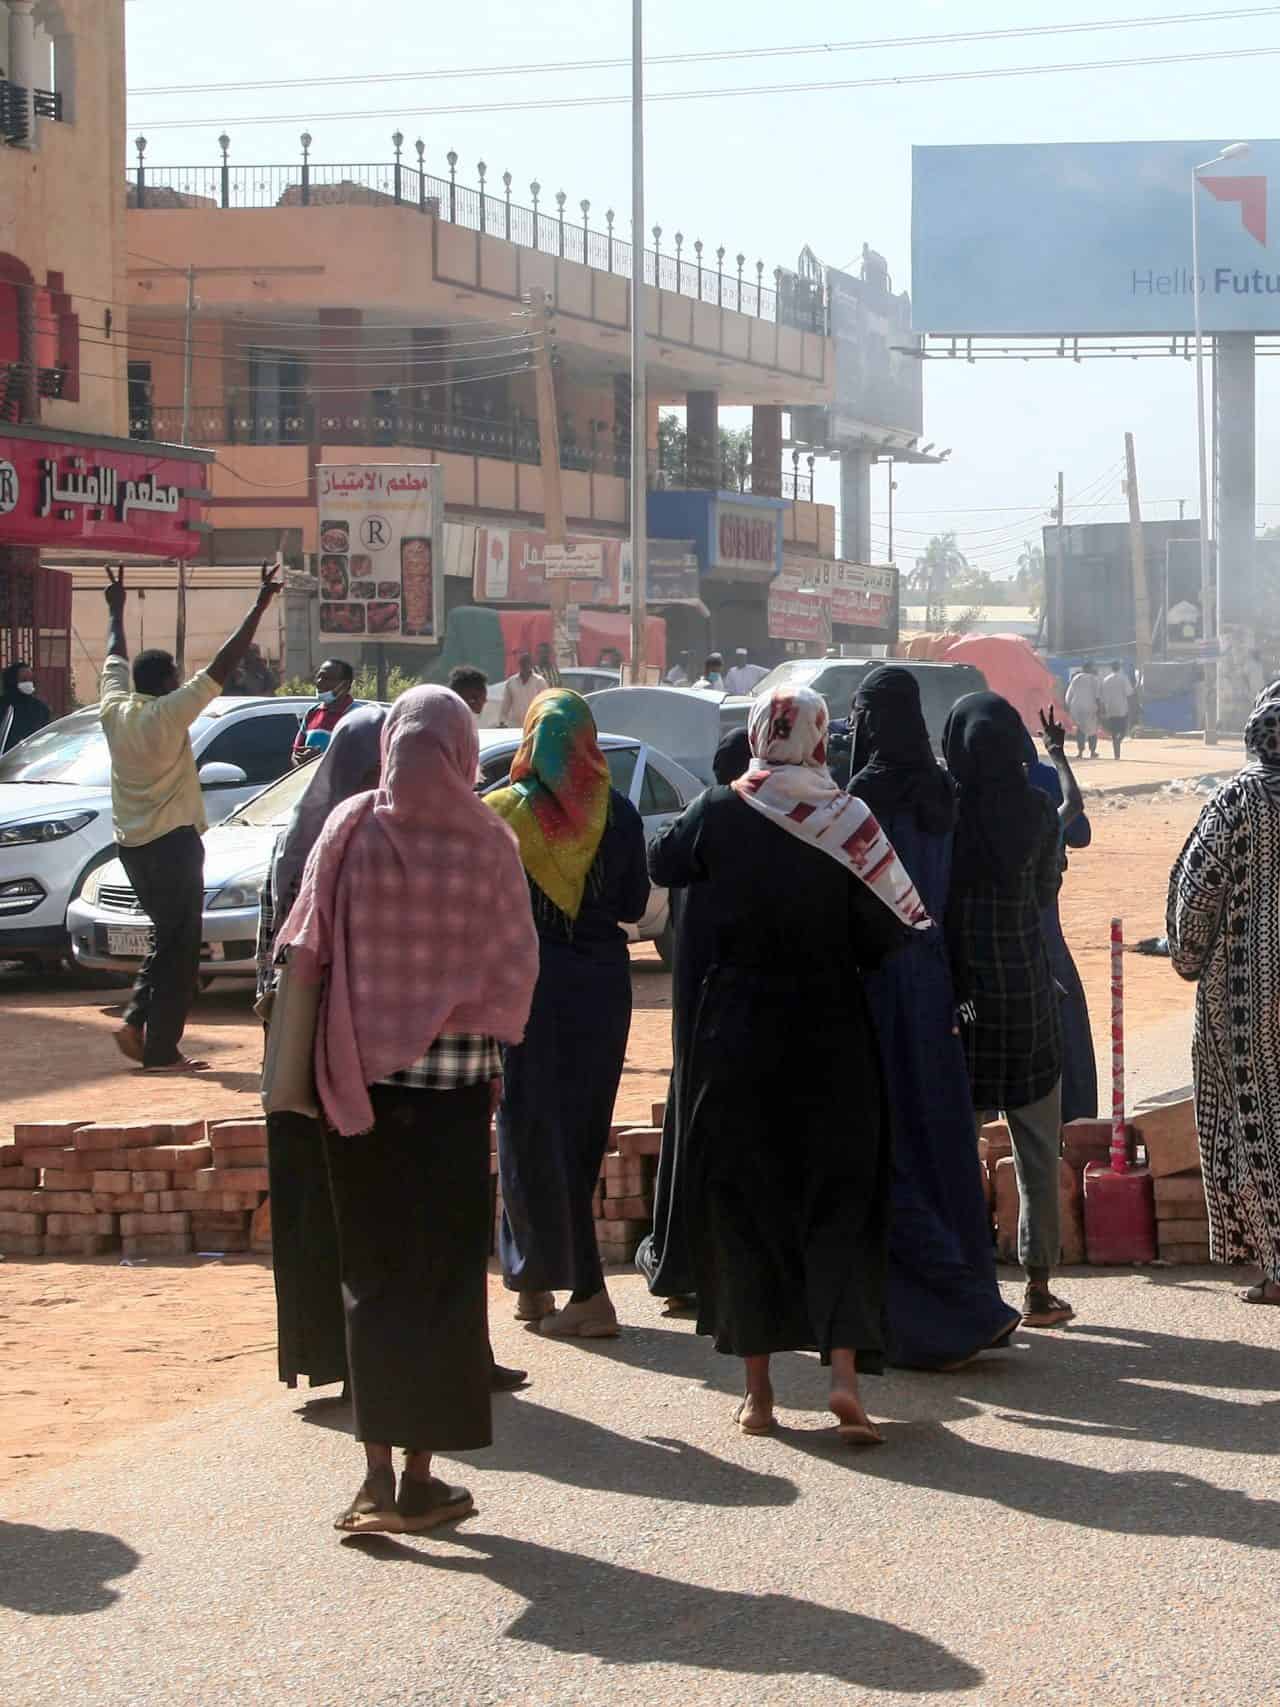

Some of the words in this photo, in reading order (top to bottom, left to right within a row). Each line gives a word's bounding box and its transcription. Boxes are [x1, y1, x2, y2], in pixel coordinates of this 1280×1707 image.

[1131, 268, 1206, 296] Hello
[122, 472, 179, 523] مطعم
[385, 472, 428, 497] مطعم
[367, 519, 386, 545] R
